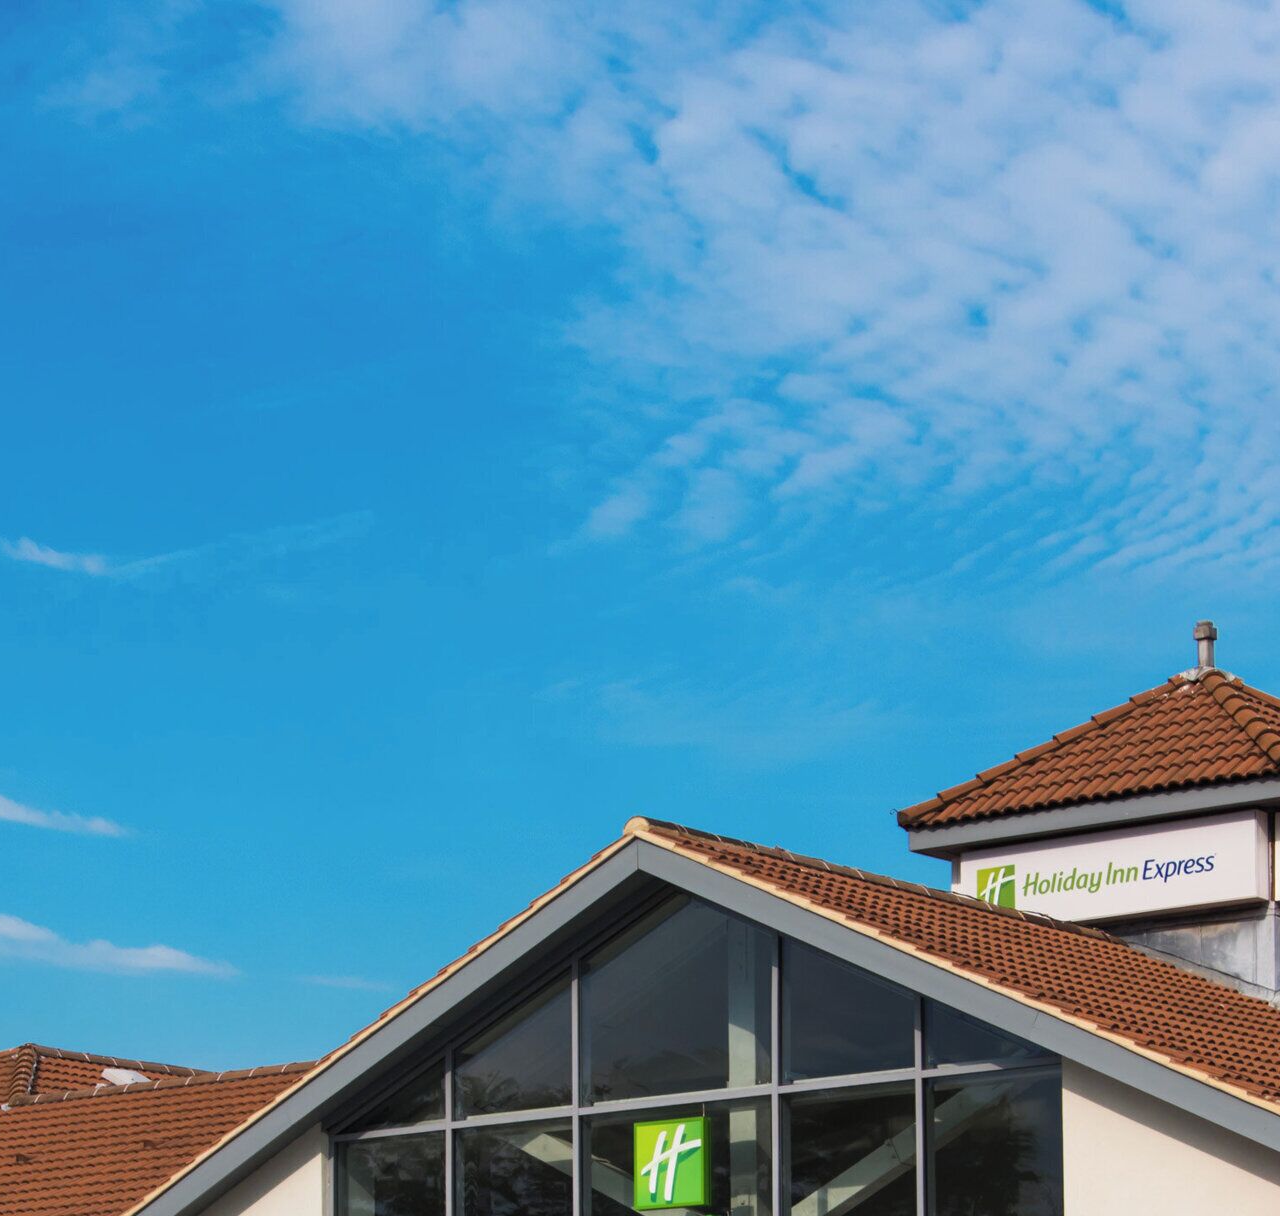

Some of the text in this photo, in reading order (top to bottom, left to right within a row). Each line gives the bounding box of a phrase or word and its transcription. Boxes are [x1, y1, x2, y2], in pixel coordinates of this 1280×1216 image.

[1022, 855, 1215, 896] Holiday Inn Express
